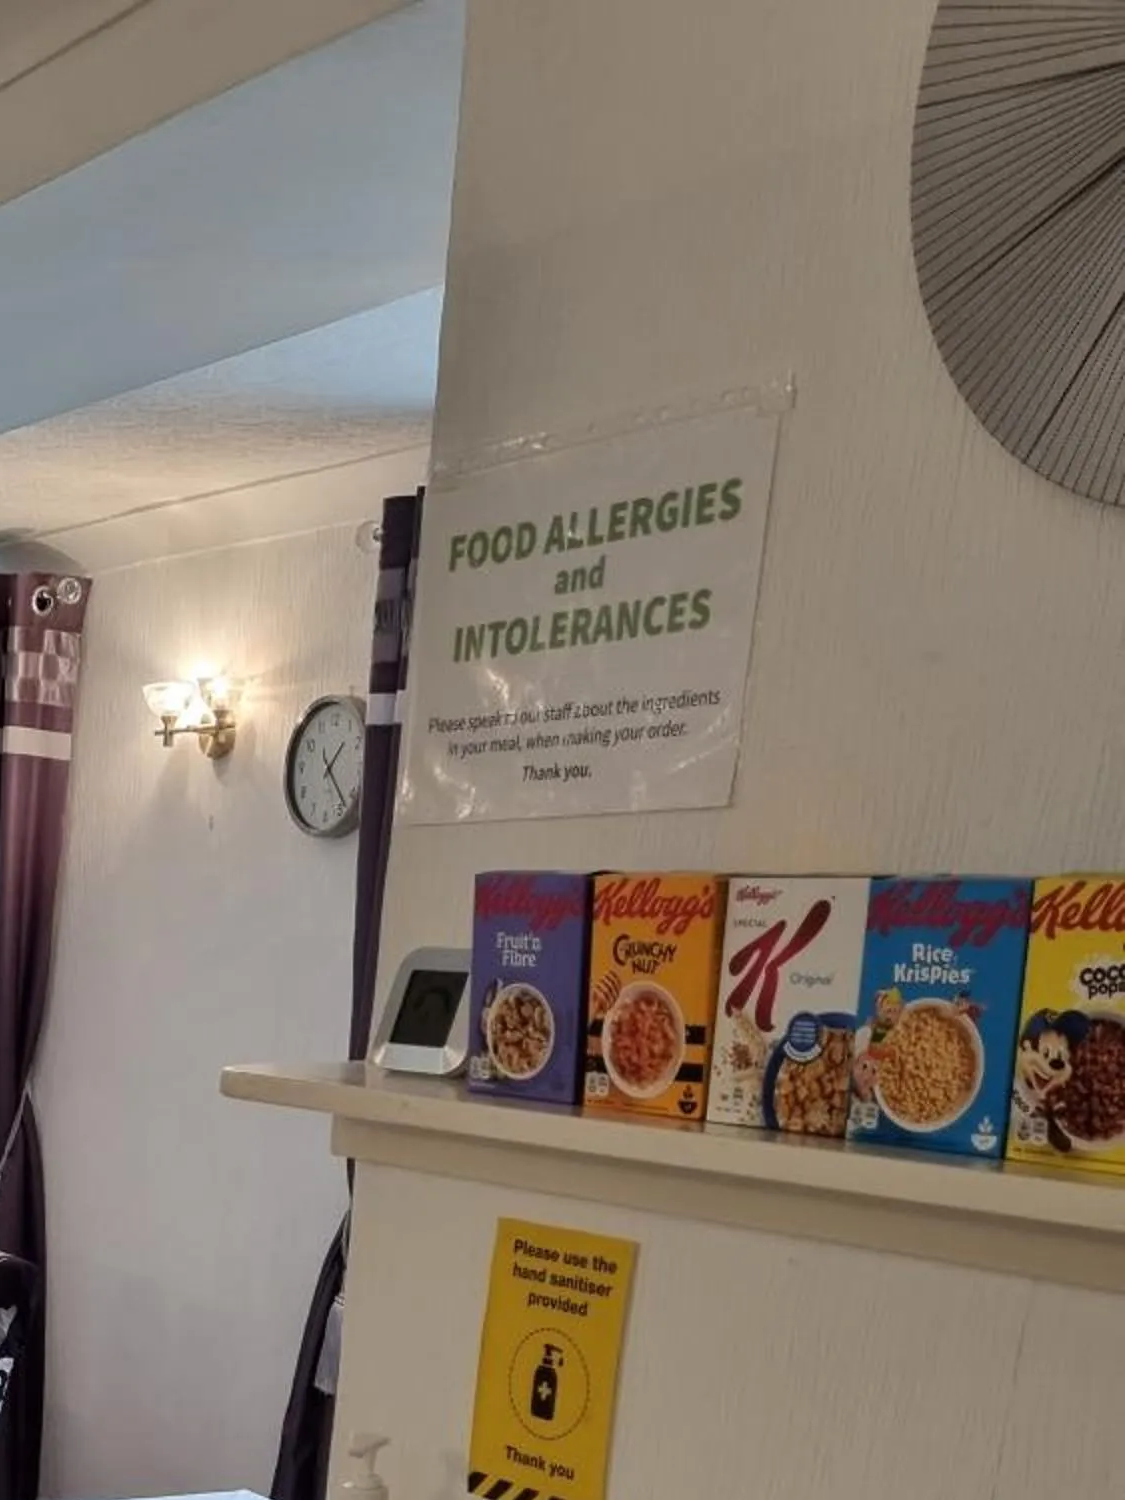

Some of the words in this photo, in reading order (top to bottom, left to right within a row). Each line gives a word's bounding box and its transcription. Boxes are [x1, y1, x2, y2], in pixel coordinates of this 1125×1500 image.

[448, 521, 537, 572] FOOD
[543, 478, 743, 555] ALLERGIES
[553, 555, 606, 595] and
[452, 588, 713, 663] INTOLERANCES
[428, 716, 466, 734] Please
[543, 702, 573, 722] staff
[615, 696, 639, 714] the
[641, 689, 721, 714] ingredients
[460, 741, 487, 760] your
[526, 731, 560, 749] when
[611, 725, 645, 748] your
[522, 762, 562, 782] Thank
[563, 763, 592, 782] you.
[593, 877, 715, 936] Kellogg's
[501, 949, 537, 968] Fibre
[631, 959, 661, 976] NUT
[725, 898, 832, 1034] K
[912, 944, 954, 966] Rice
[893, 963, 971, 986] Krispies
[513, 1238, 560, 1264] Please
[563, 1252, 588, 1269] use
[592, 1256, 618, 1275] the
[512, 1263, 549, 1285] hand
[550, 1272, 613, 1298] sanitiser
[527, 1292, 589, 1317] provided
[506, 1445, 546, 1472] Thank
[547, 1461, 575, 1481] you
